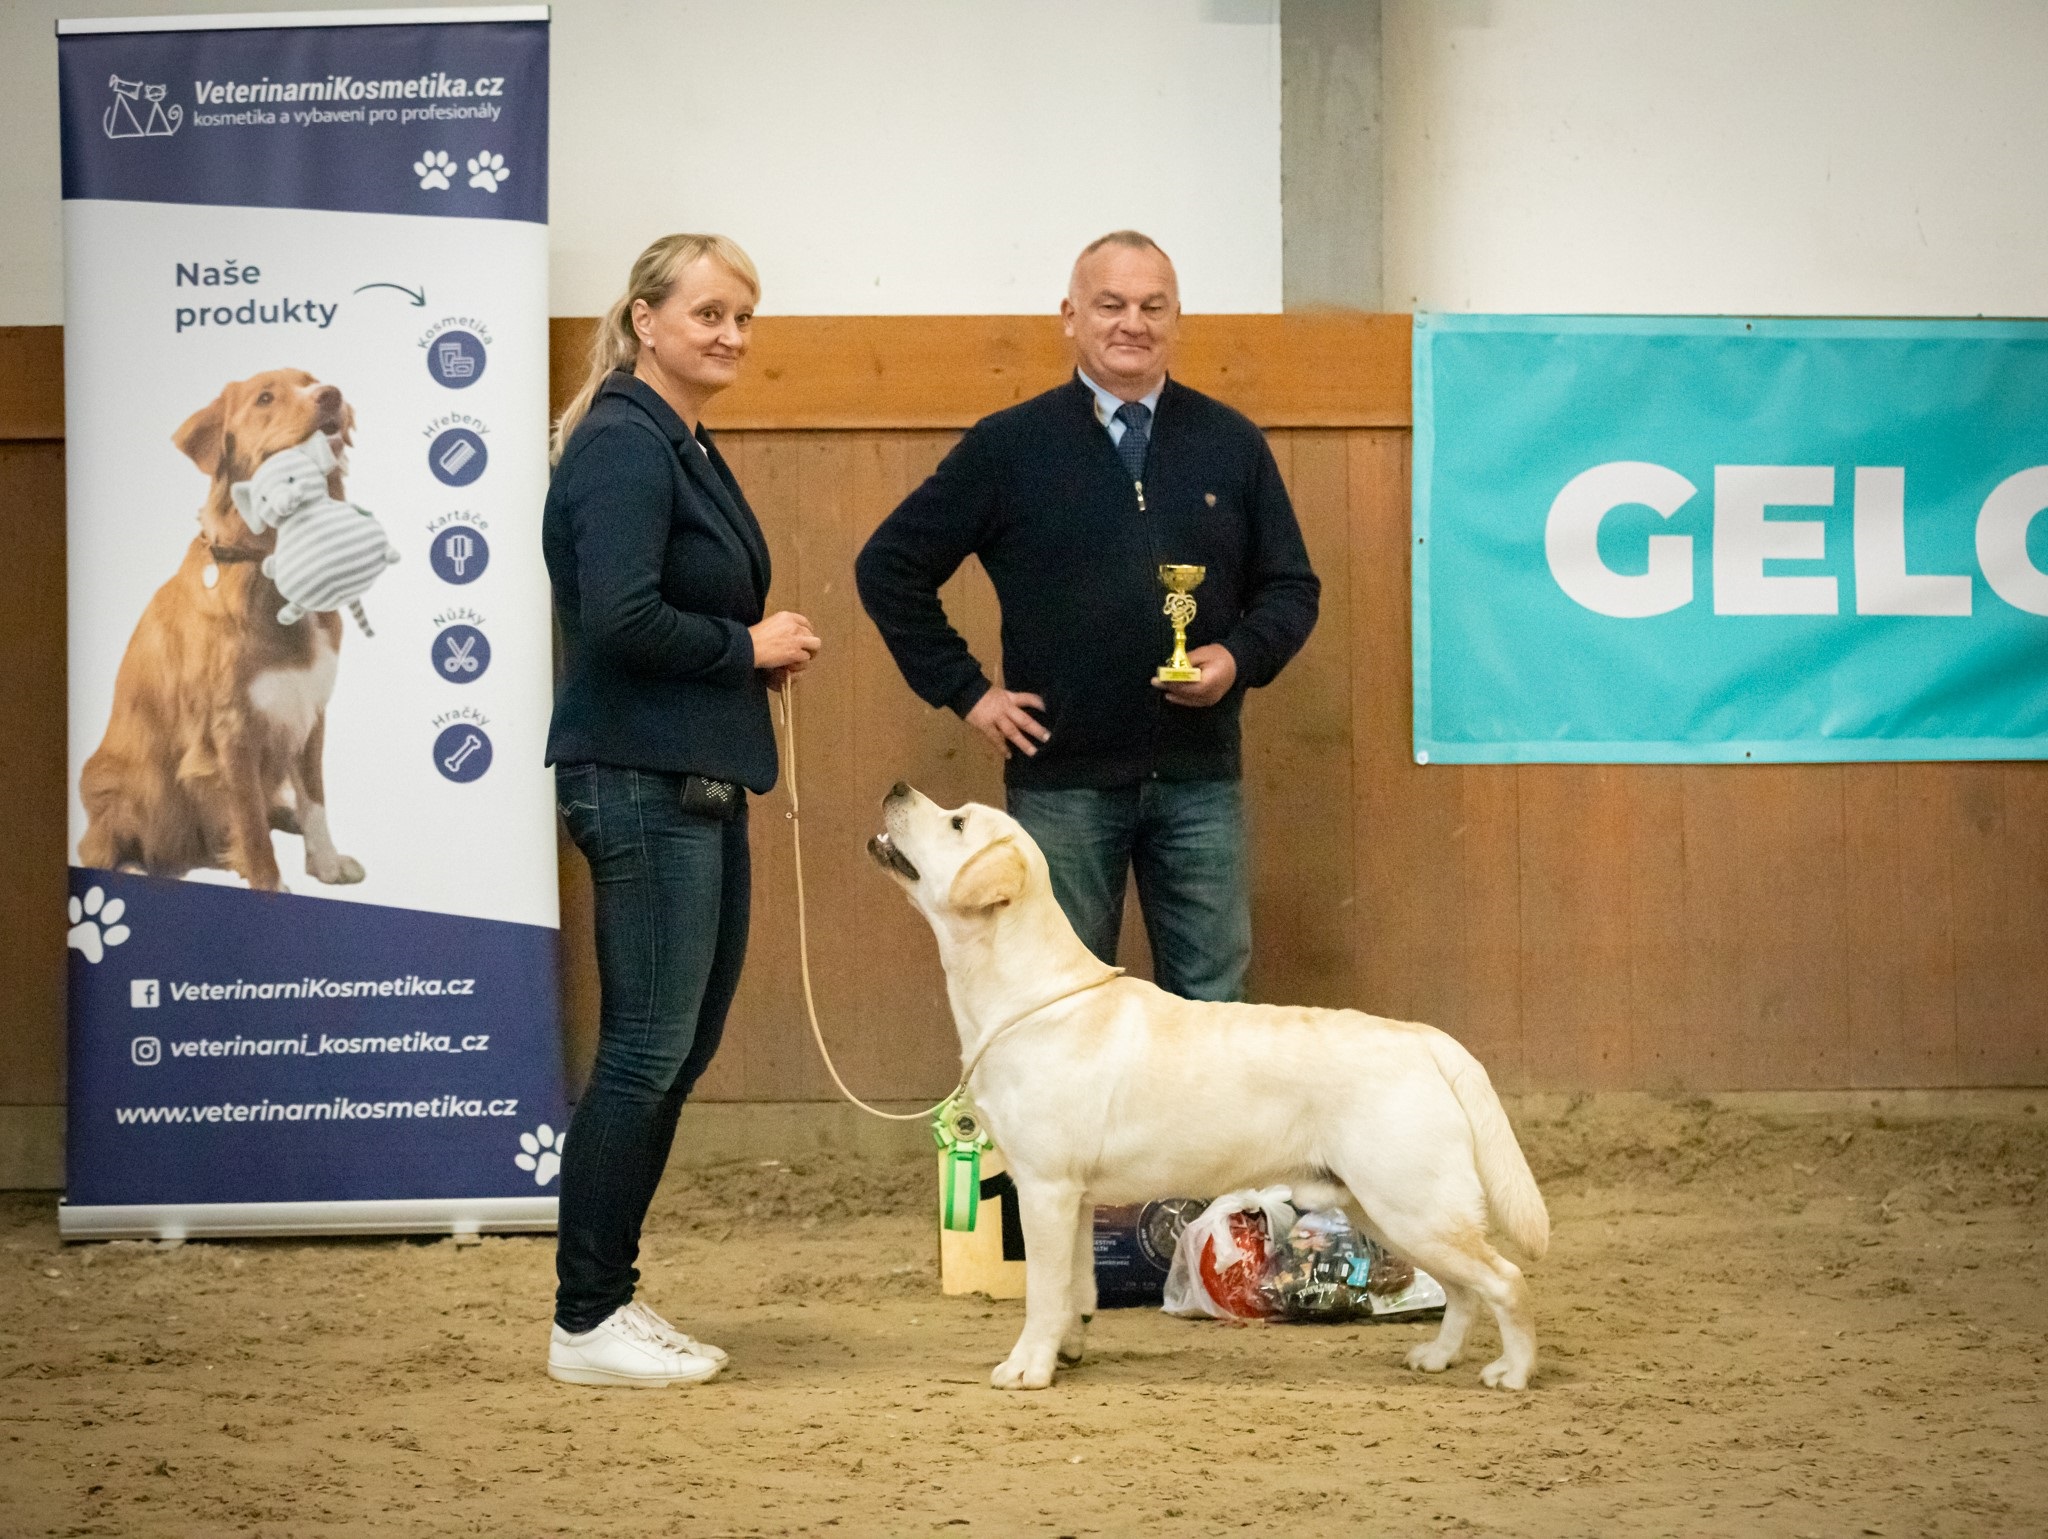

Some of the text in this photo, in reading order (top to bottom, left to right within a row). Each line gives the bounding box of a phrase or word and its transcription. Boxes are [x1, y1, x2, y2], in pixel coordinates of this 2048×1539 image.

[194, 72, 505, 105] VeterinarniKosmetika.cz
[193, 103, 501, 127] kosmetika a vybavení pro profesionály
[176, 260, 261, 287] Naše
[175, 297, 338, 333] produkty
[417, 316, 494, 349] Kosmetika
[423, 412, 491, 438] Hřebeny
[427, 510, 488, 533] Kartáče
[432, 705, 491, 728] Hračky
[170, 976, 475, 1001] VeterinarniKosmetika.cz
[171, 1032, 489, 1057] veterinarni_kosmetika_cz
[116, 1096, 518, 1124] www.veterinarnikosmetika.cz
